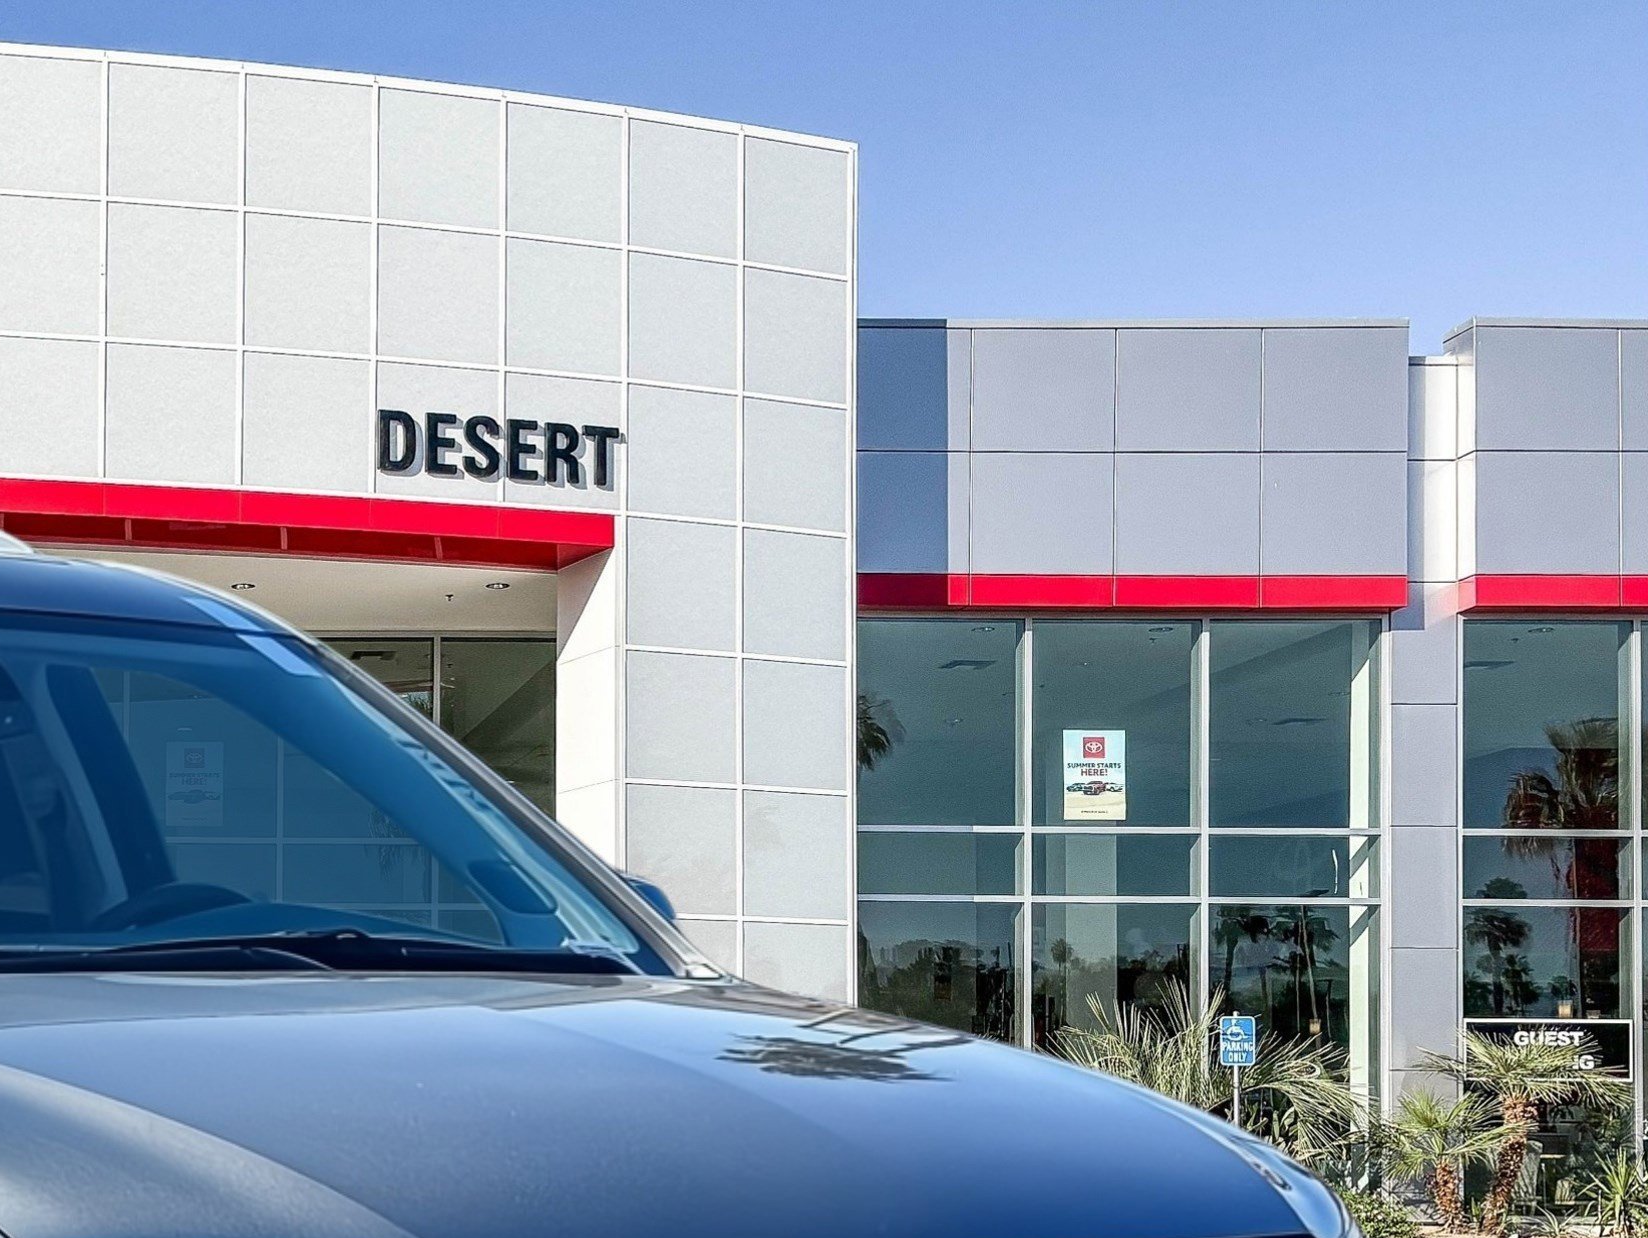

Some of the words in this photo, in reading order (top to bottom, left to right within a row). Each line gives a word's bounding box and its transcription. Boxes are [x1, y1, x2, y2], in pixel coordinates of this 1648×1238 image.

[377, 409, 620, 487] DESERT
[1081, 768, 1108, 777] HERE!
[1513, 1030, 1584, 1046] GUEST
[1223, 1041, 1253, 1052] PARKING
[1228, 1052, 1247, 1062] ONLY
